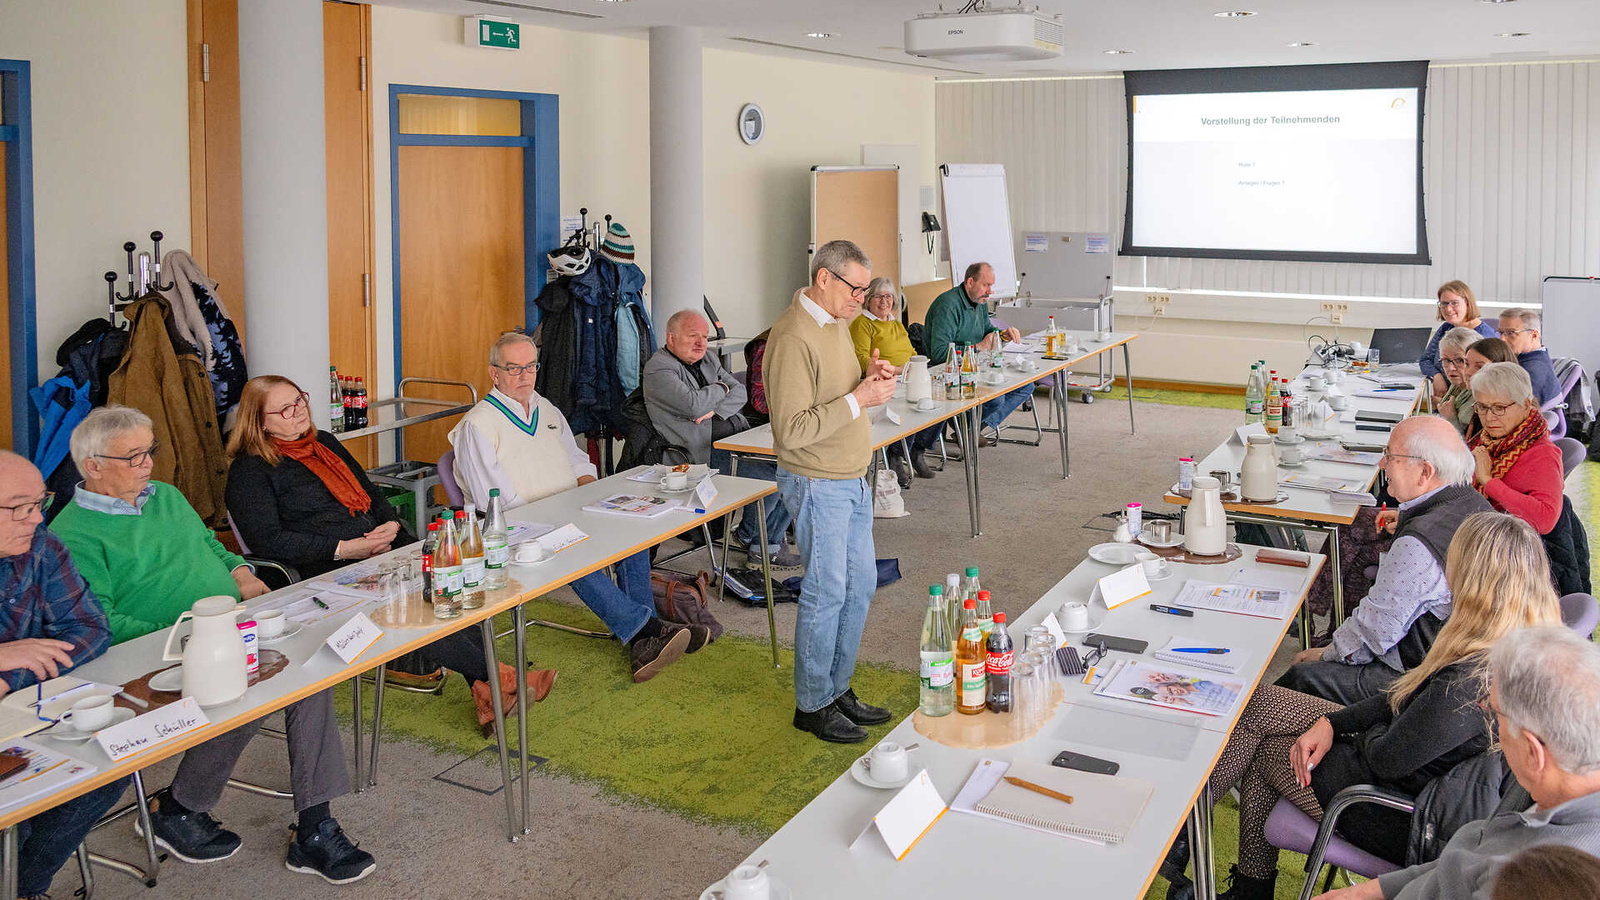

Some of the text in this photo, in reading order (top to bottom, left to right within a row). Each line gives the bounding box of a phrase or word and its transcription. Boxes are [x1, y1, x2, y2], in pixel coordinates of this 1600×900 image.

[1200, 115, 1340, 126] Vorstellung der Teilnehmenden
[154, 718, 197, 738] Schüller
